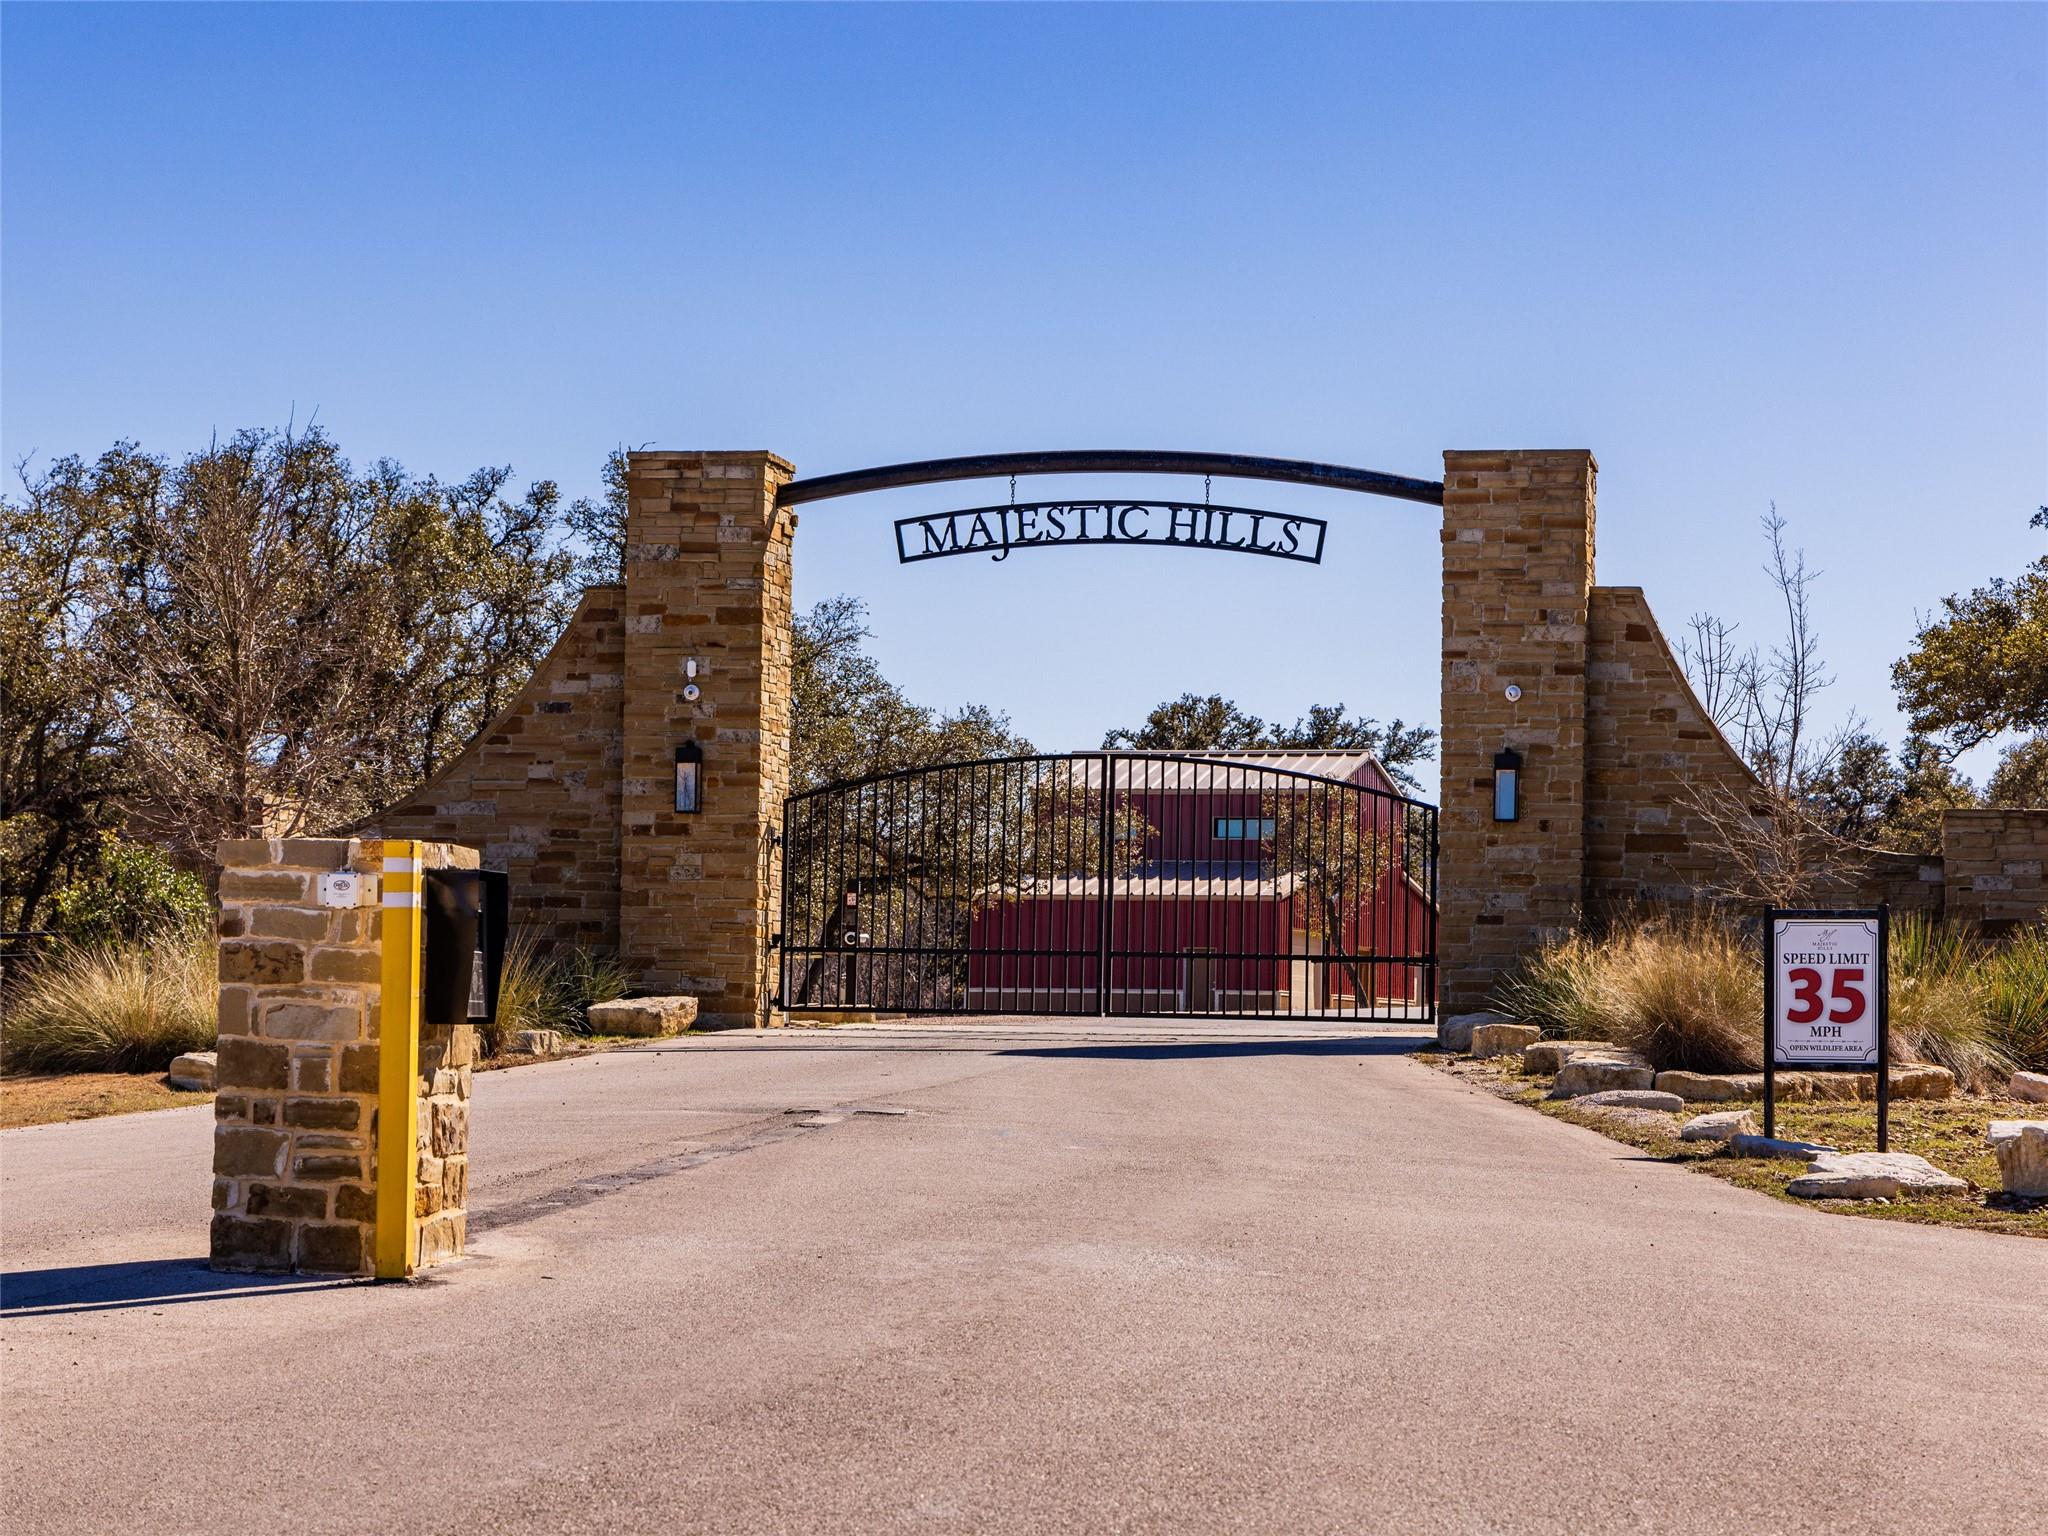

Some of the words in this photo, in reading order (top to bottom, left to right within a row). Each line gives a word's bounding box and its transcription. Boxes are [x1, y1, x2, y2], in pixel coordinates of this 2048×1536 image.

[919, 505, 1149, 561] MAJESTIC
[1165, 506, 1302, 555] HILLS
[1783, 953, 1826, 965] SPEED
[1829, 953, 1870, 965] LIMIT
[1786, 967, 1866, 1024] 35
[1810, 1026, 1842, 1037] MPH
